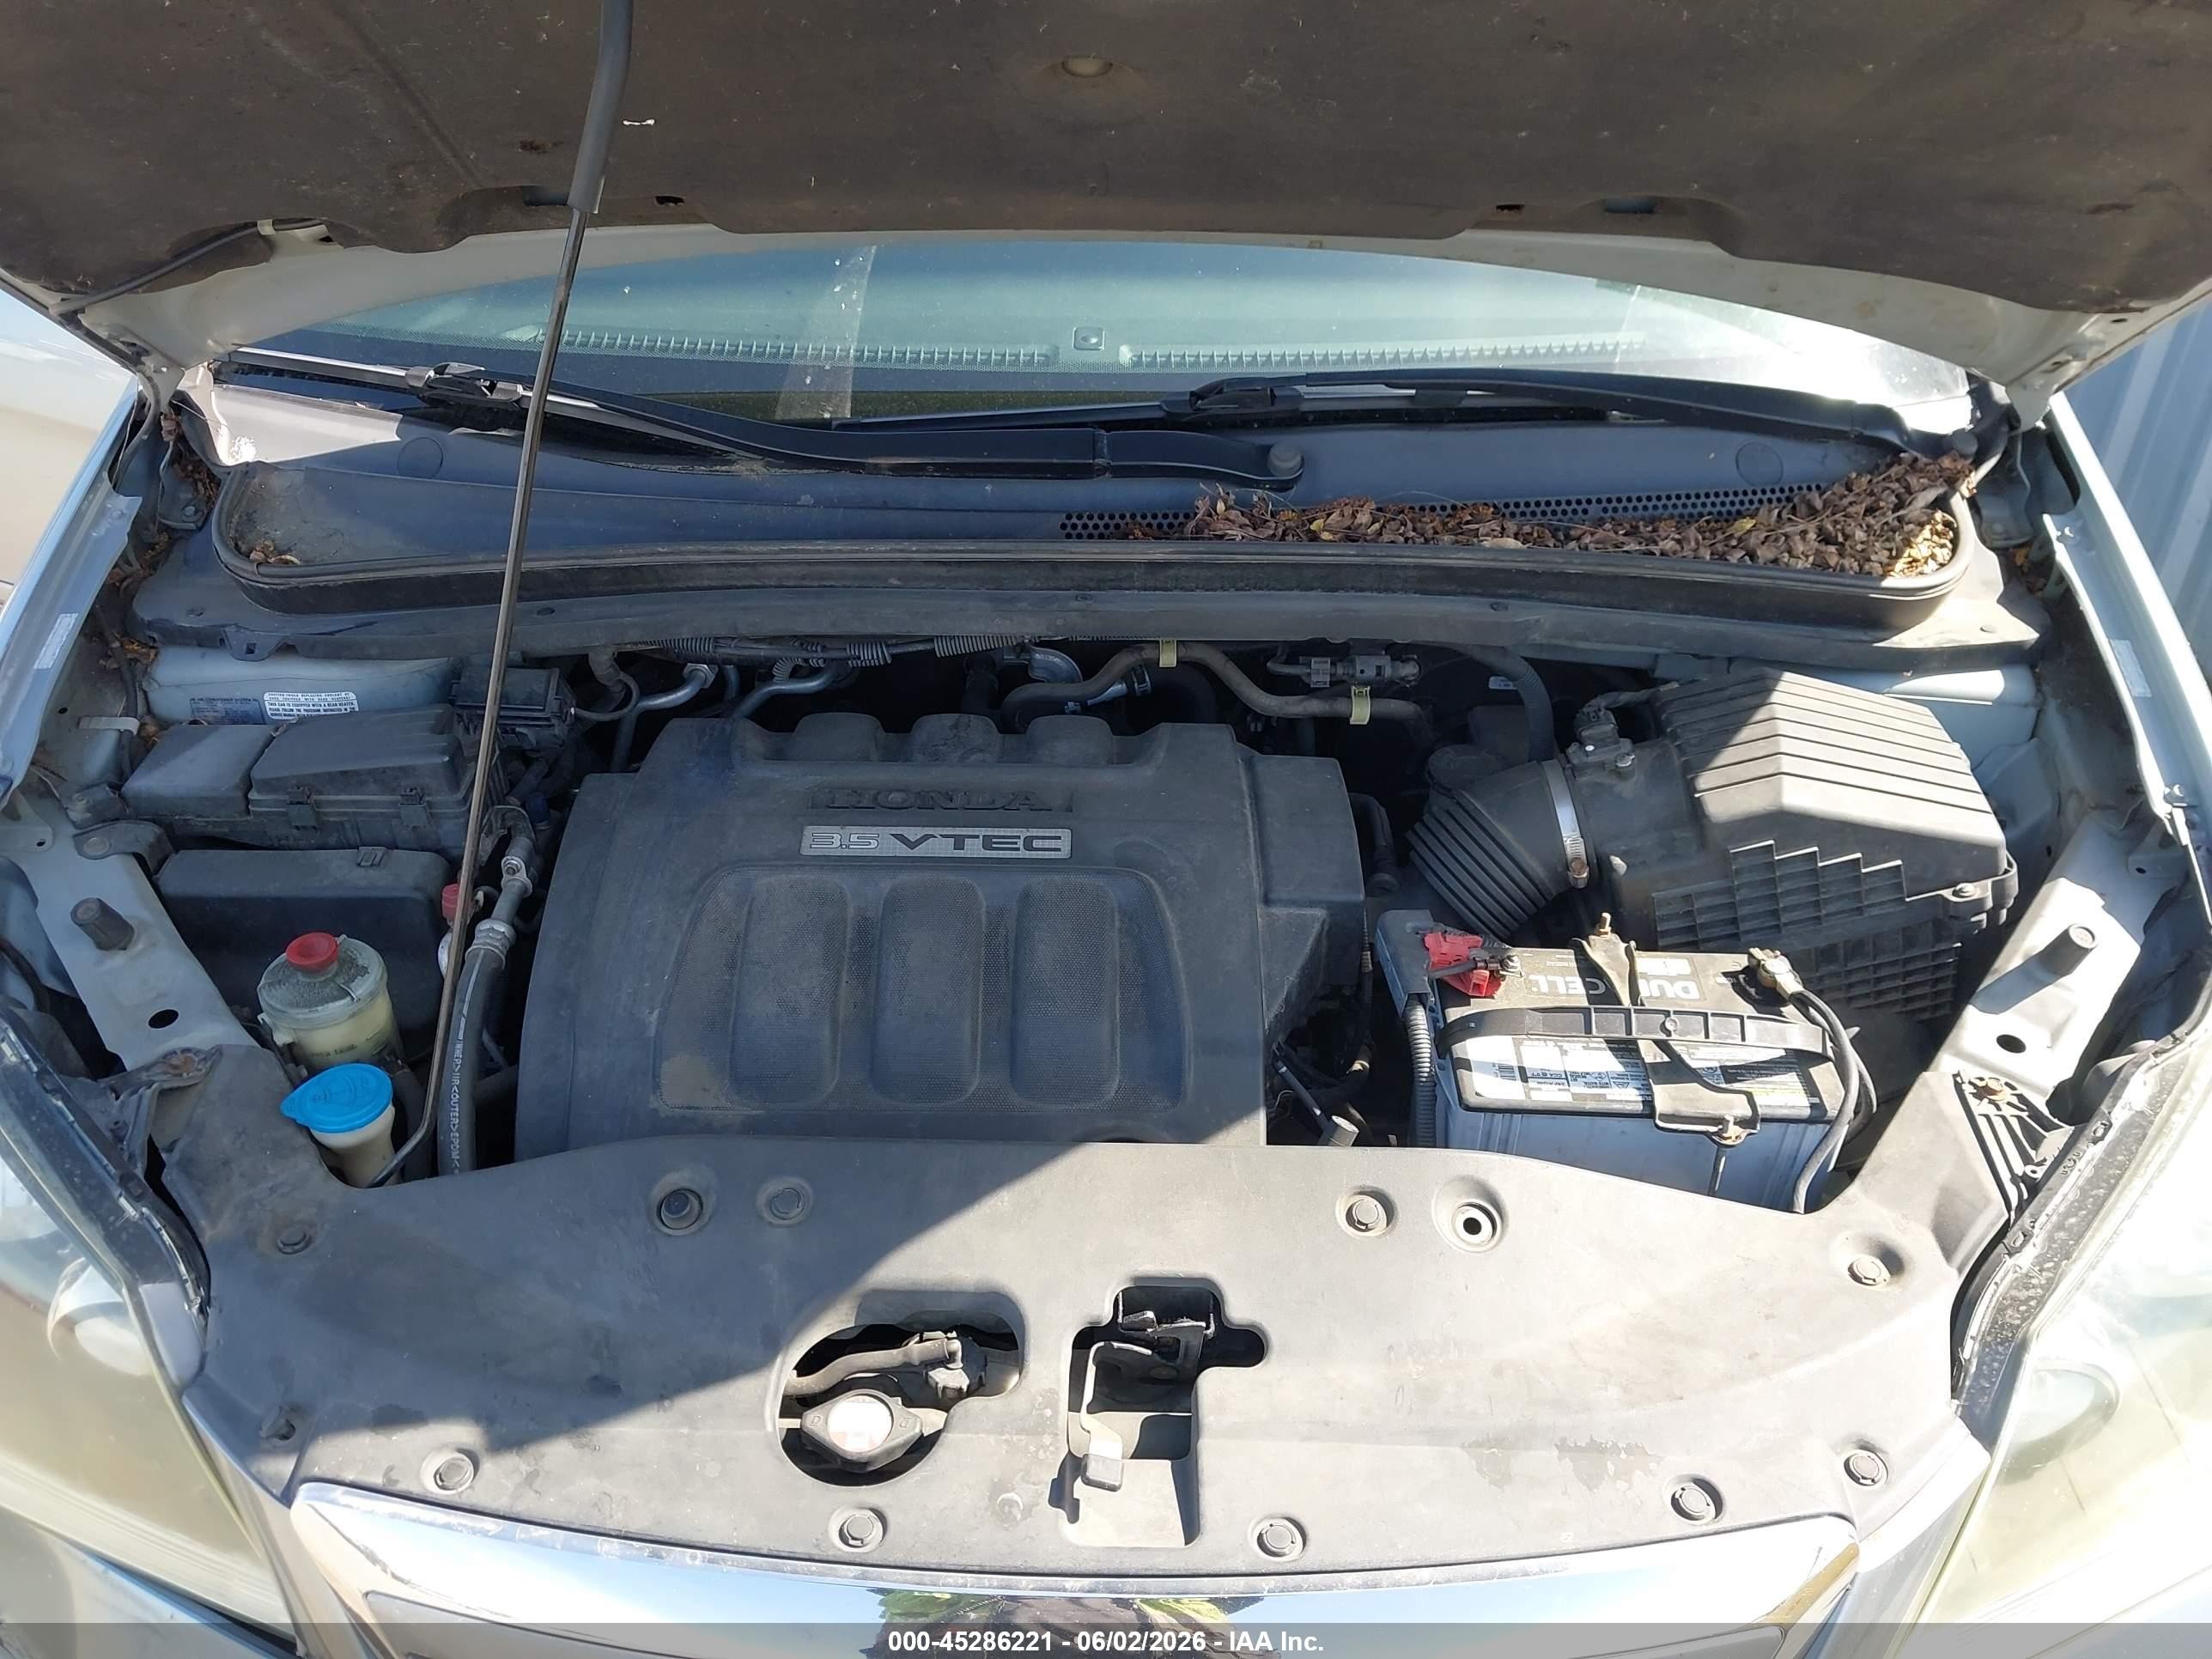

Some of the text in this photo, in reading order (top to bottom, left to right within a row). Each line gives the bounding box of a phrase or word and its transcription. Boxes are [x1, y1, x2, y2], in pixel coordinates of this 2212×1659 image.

[826, 789, 1053, 811] HONDA
[810, 832, 1062, 852] 3.5 VTEC
[1528, 975, 1700, 1000] DUCELL
